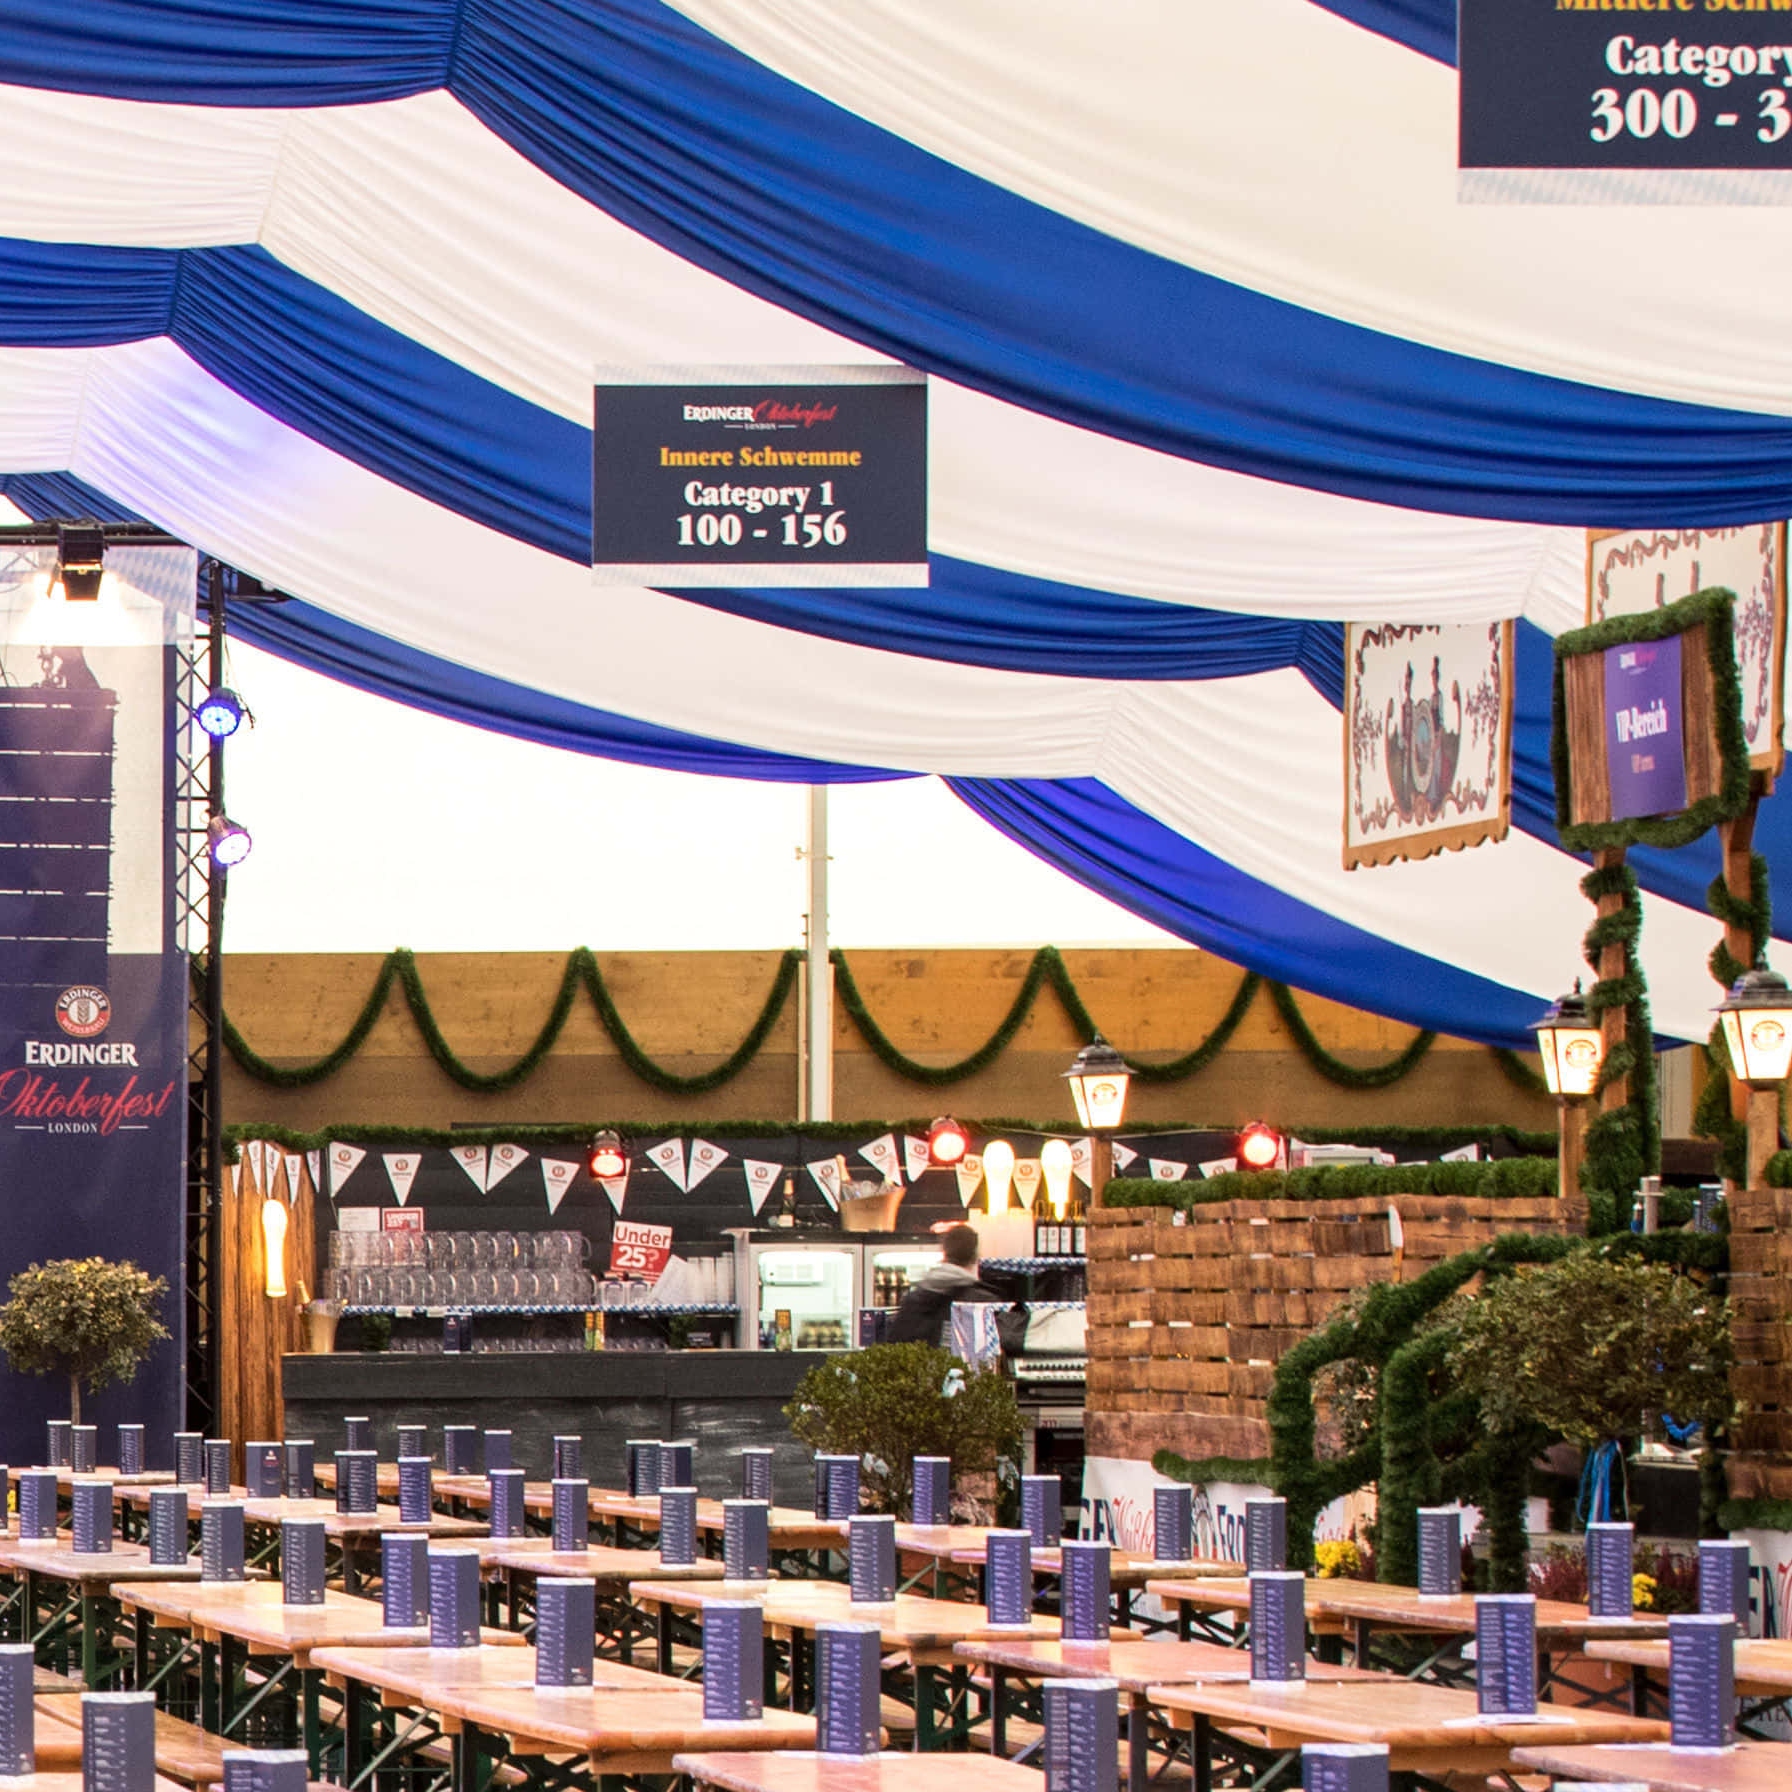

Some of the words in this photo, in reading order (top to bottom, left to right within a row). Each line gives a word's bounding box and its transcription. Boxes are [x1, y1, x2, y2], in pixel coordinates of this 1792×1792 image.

[1590, 87, 1698, 143] 300
[1715, 113, 1739, 126] -
[1757, 87, 1792, 144] 3
[683, 405, 755, 422] ERDINGER
[752, 400, 838, 428] Oktoberfest
[660, 447, 734, 467] Innere
[739, 446, 862, 467] Schwemme
[683, 481, 811, 514] Category
[819, 481, 834, 507] 1
[676, 513, 743, 546] 100
[752, 528, 768, 538] -
[781, 510, 848, 549] 156
[58, 987, 107, 1010] ERDINGER
[24, 1040, 139, 1067] ERDINGER
[48, 1122, 98, 1134] LONDON
[615, 1225, 672, 1247] Under
[615, 1245, 660, 1270] 25?
